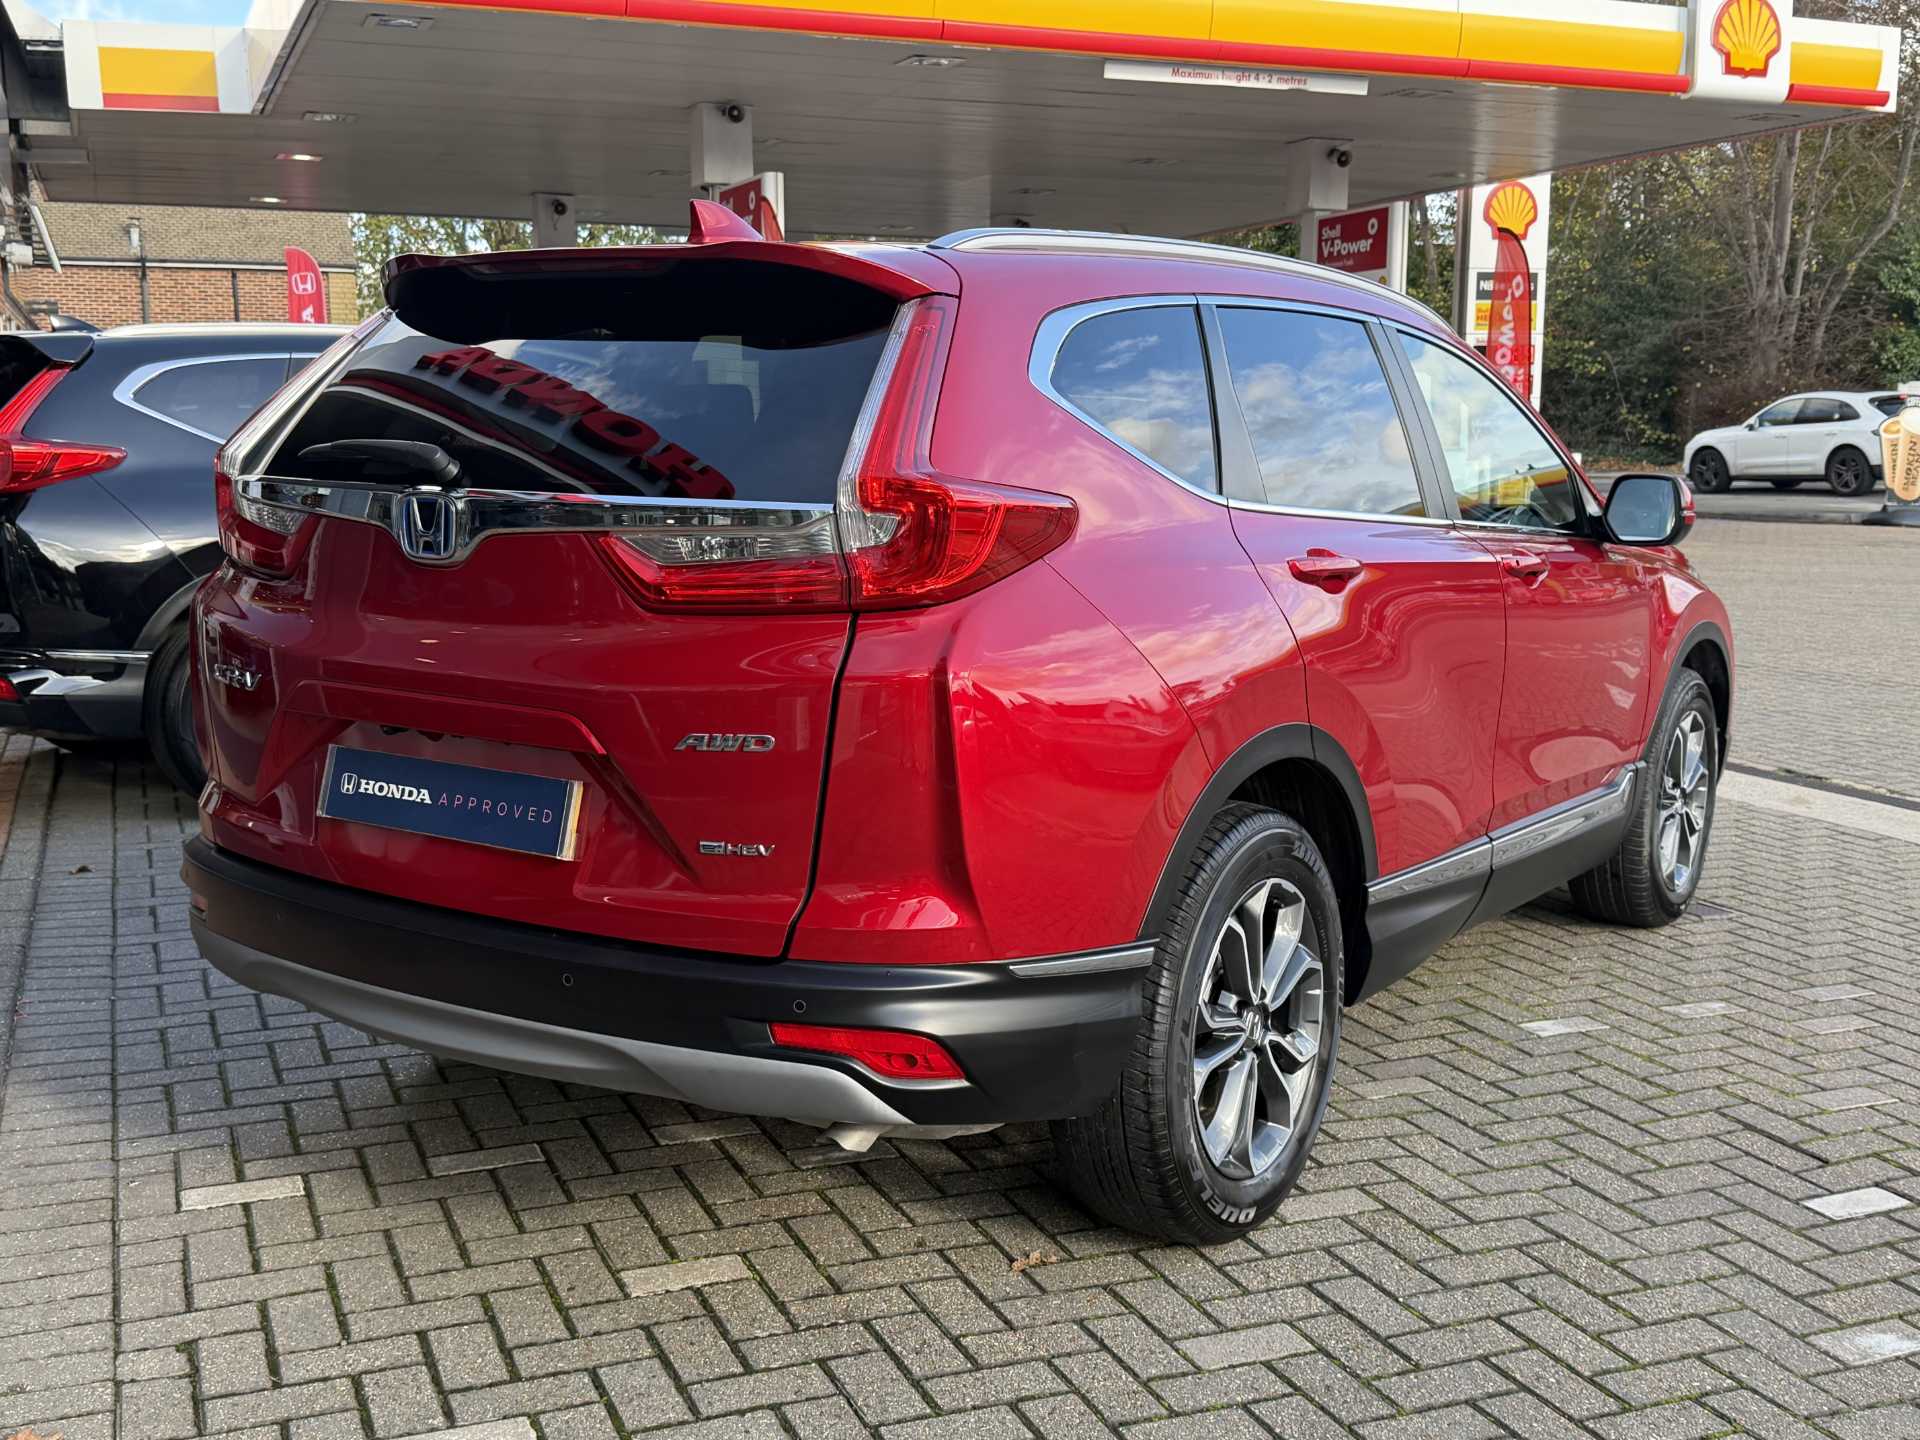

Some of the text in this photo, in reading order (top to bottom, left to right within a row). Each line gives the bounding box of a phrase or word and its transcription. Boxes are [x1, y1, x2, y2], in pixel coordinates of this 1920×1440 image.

[1221, 69, 1251, 83] hght
[1321, 224, 1342, 240] Shell
[673, 733, 776, 752] AWD
[358, 778, 553, 824] HONDA APPROVED
